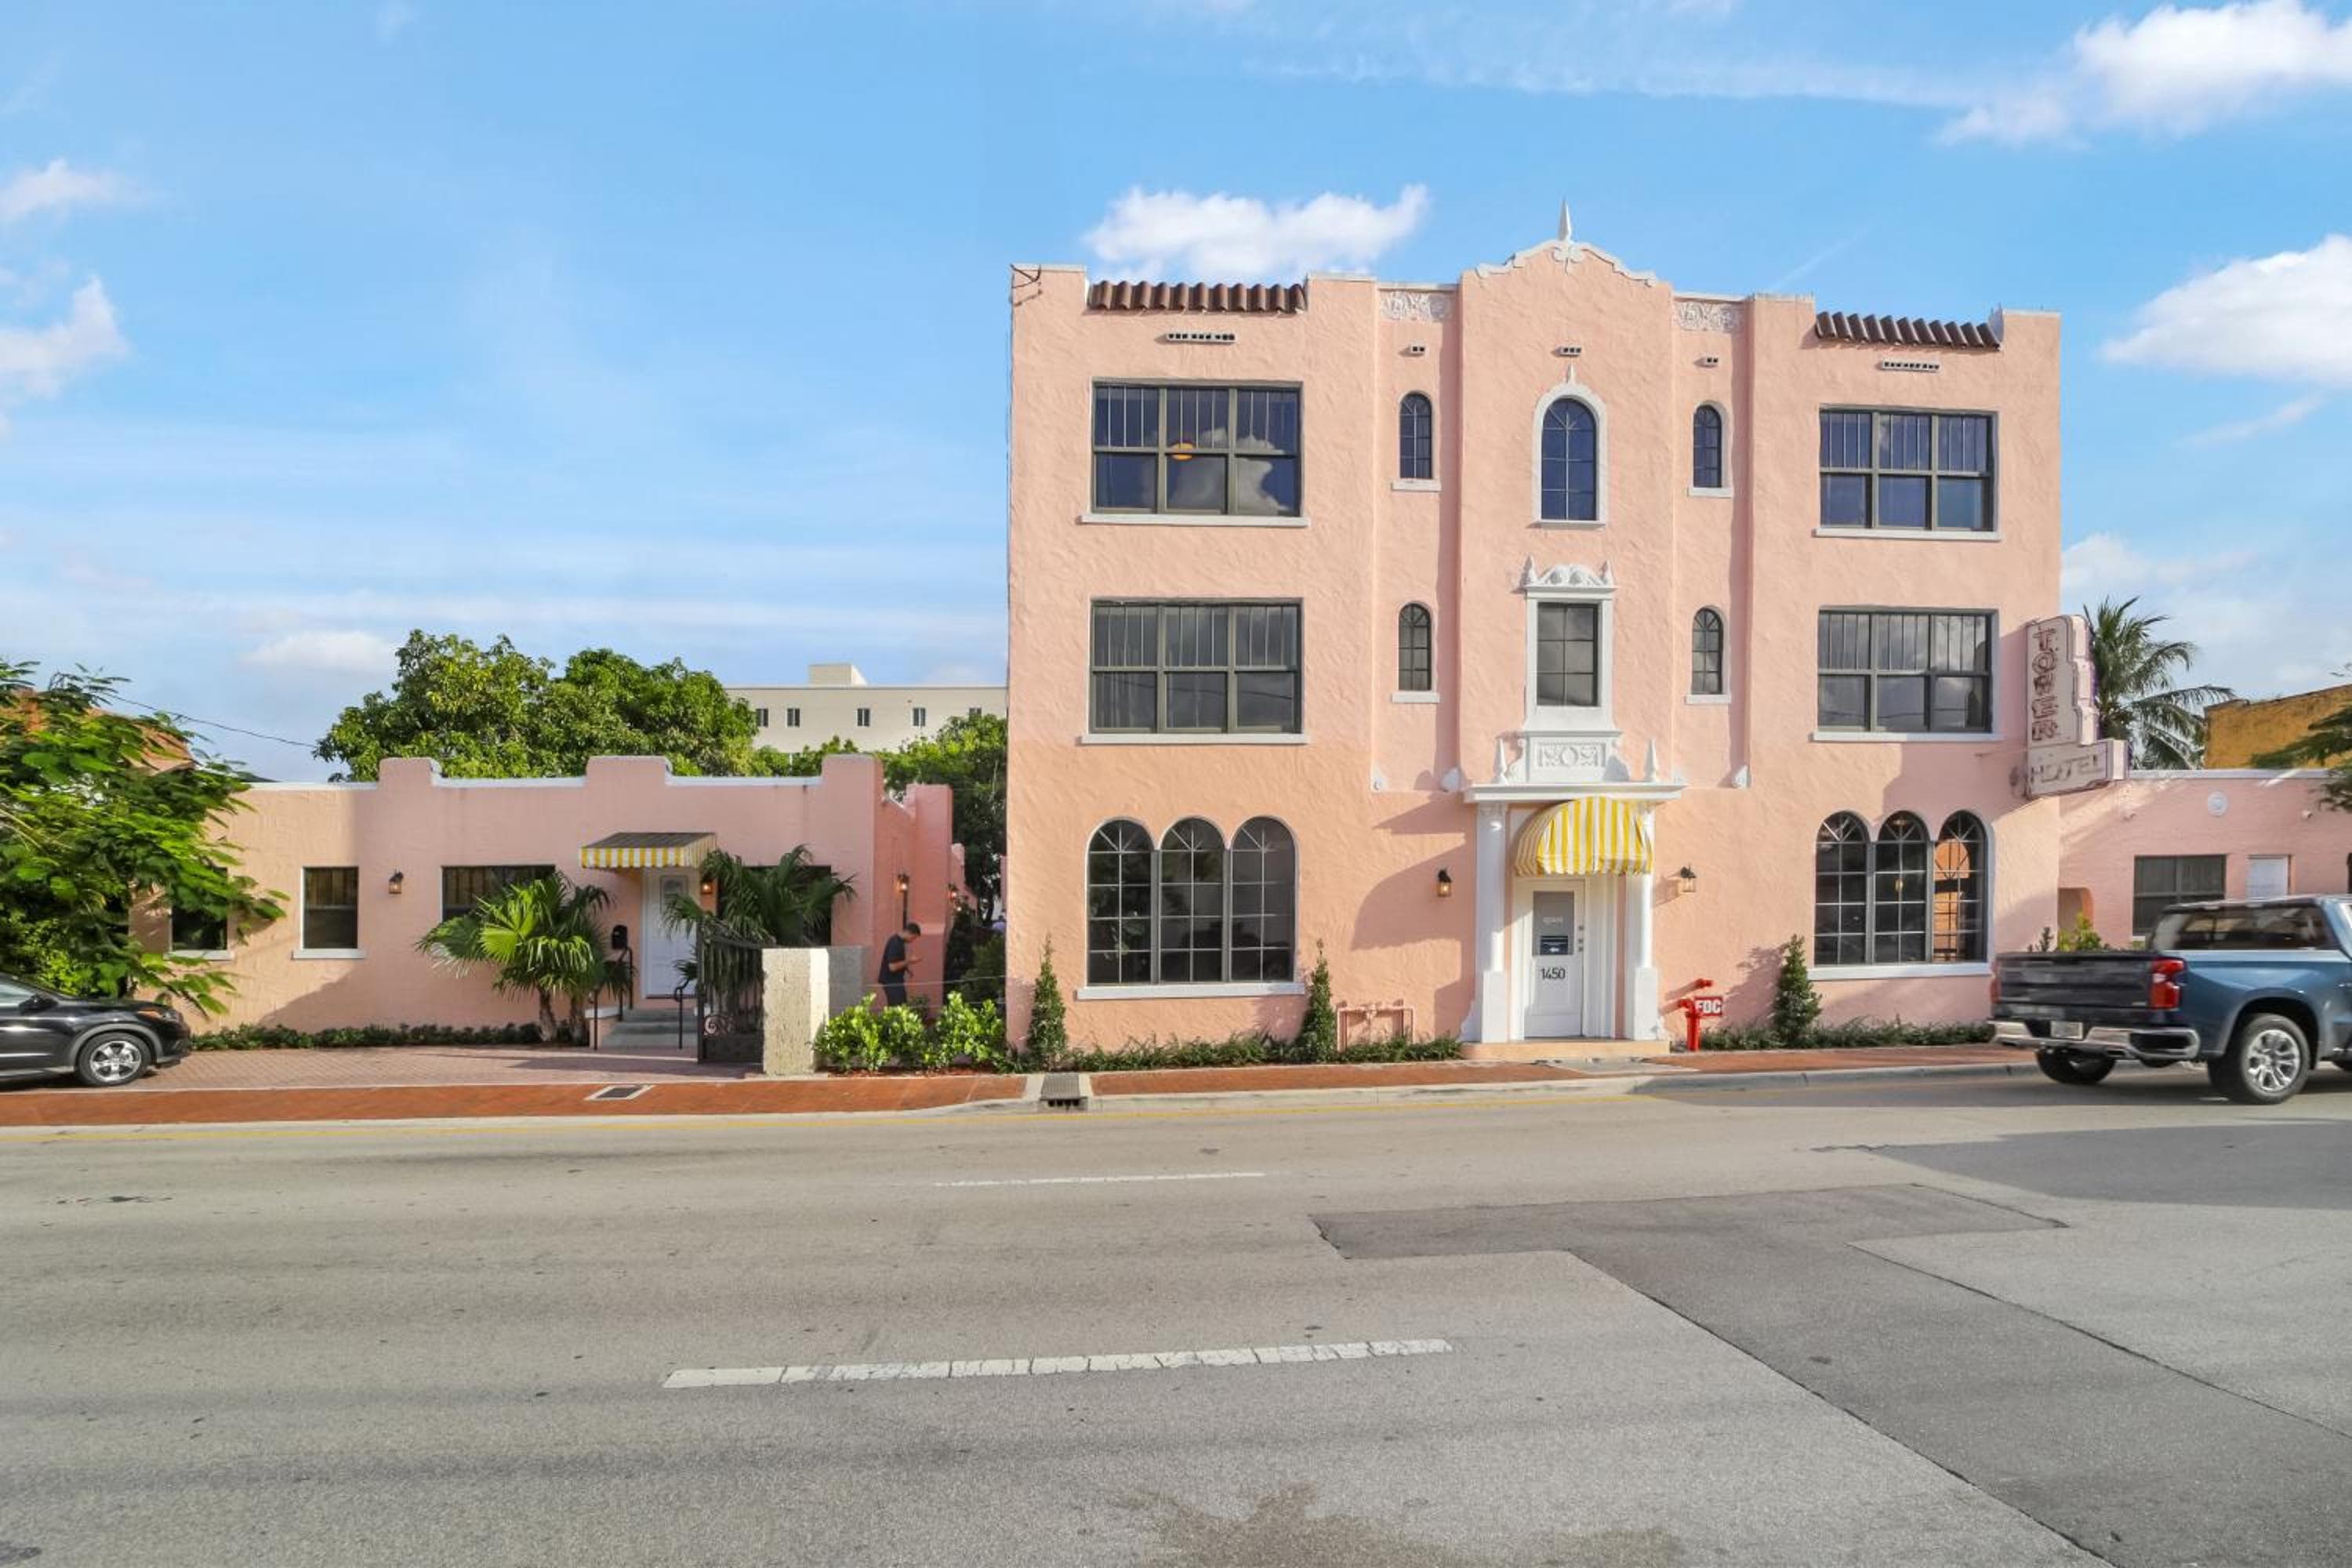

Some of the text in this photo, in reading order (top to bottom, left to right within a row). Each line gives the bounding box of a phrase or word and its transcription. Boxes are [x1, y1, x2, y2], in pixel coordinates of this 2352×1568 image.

[2031, 753, 2103, 784] HOTEL
[1541, 967, 1566, 980] 1450
[1695, 1000, 1721, 1014] FDC
